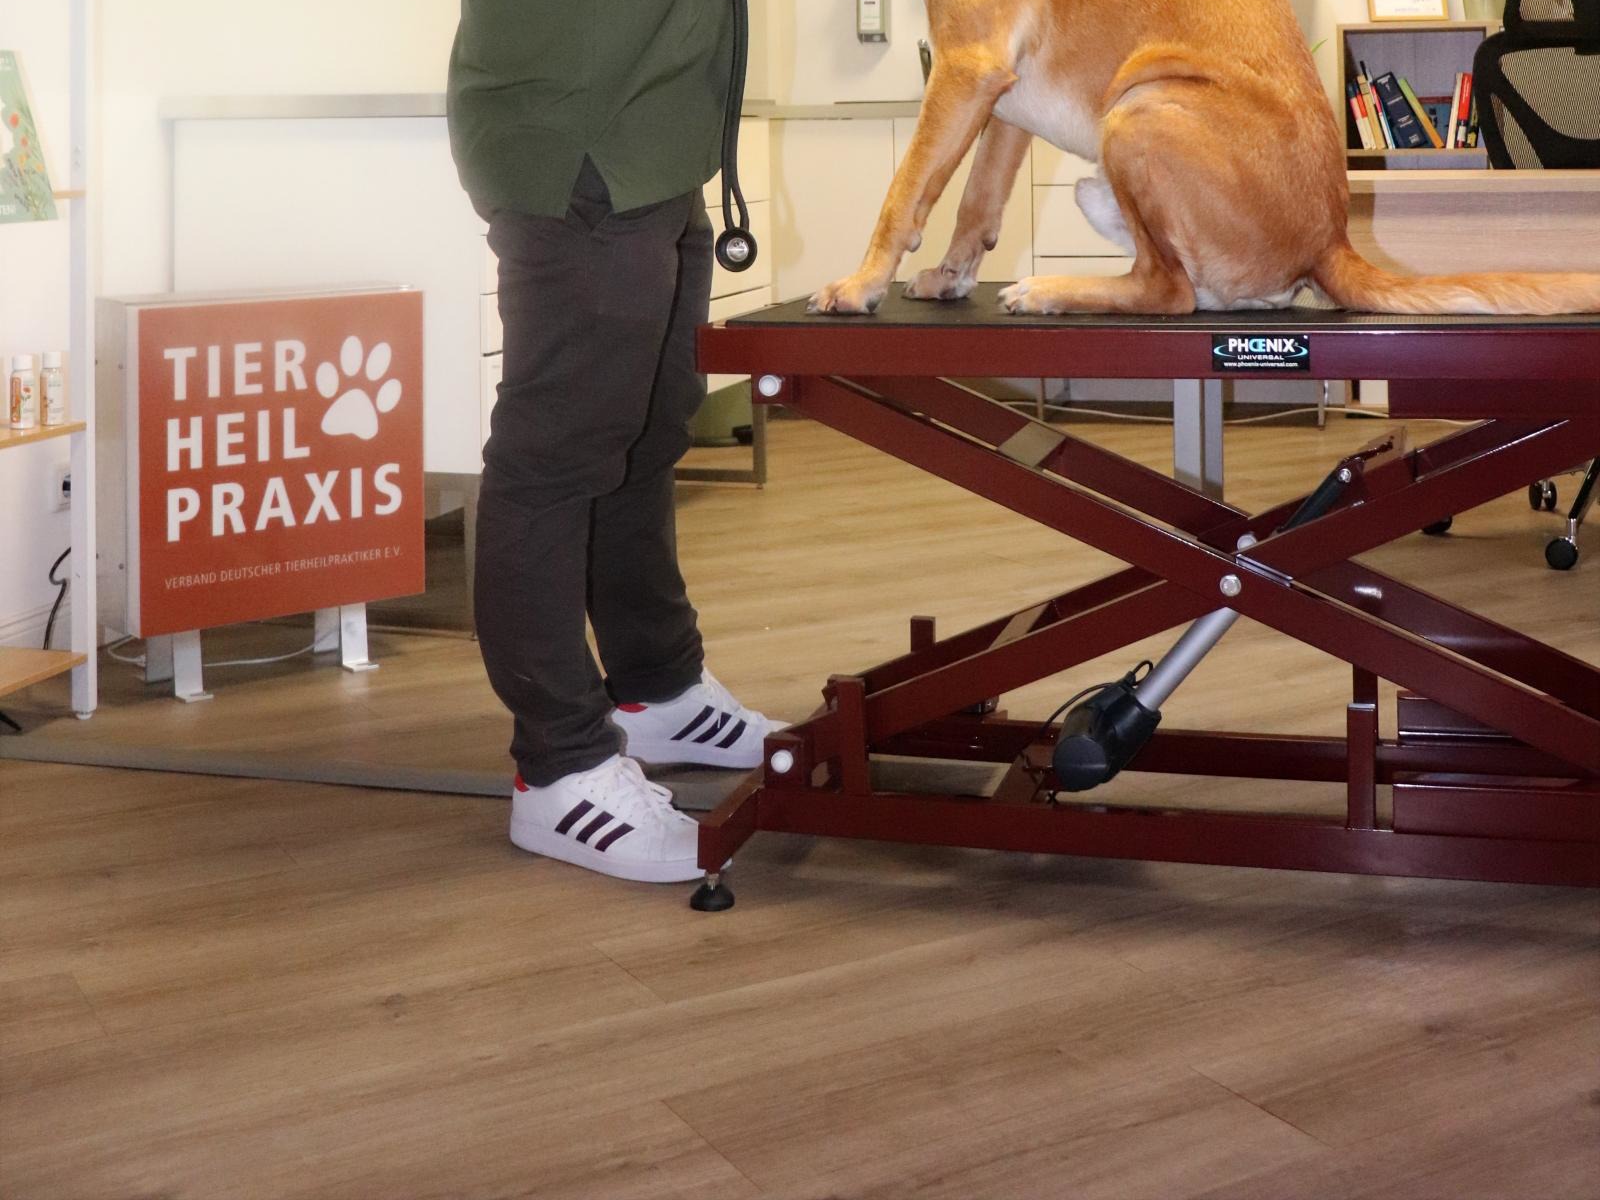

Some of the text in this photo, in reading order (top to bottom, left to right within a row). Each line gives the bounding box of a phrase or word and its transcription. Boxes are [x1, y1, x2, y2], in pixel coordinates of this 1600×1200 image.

[163, 339, 308, 401] TIER
[167, 407, 310, 472] HEIL
[167, 462, 402, 543] PRAXIS
[164, 571, 217, 590] VERBAND
[220, 561, 281, 582] DEUTSCHER
[285, 548, 381, 572] TIERHEILPRAKTIKER
